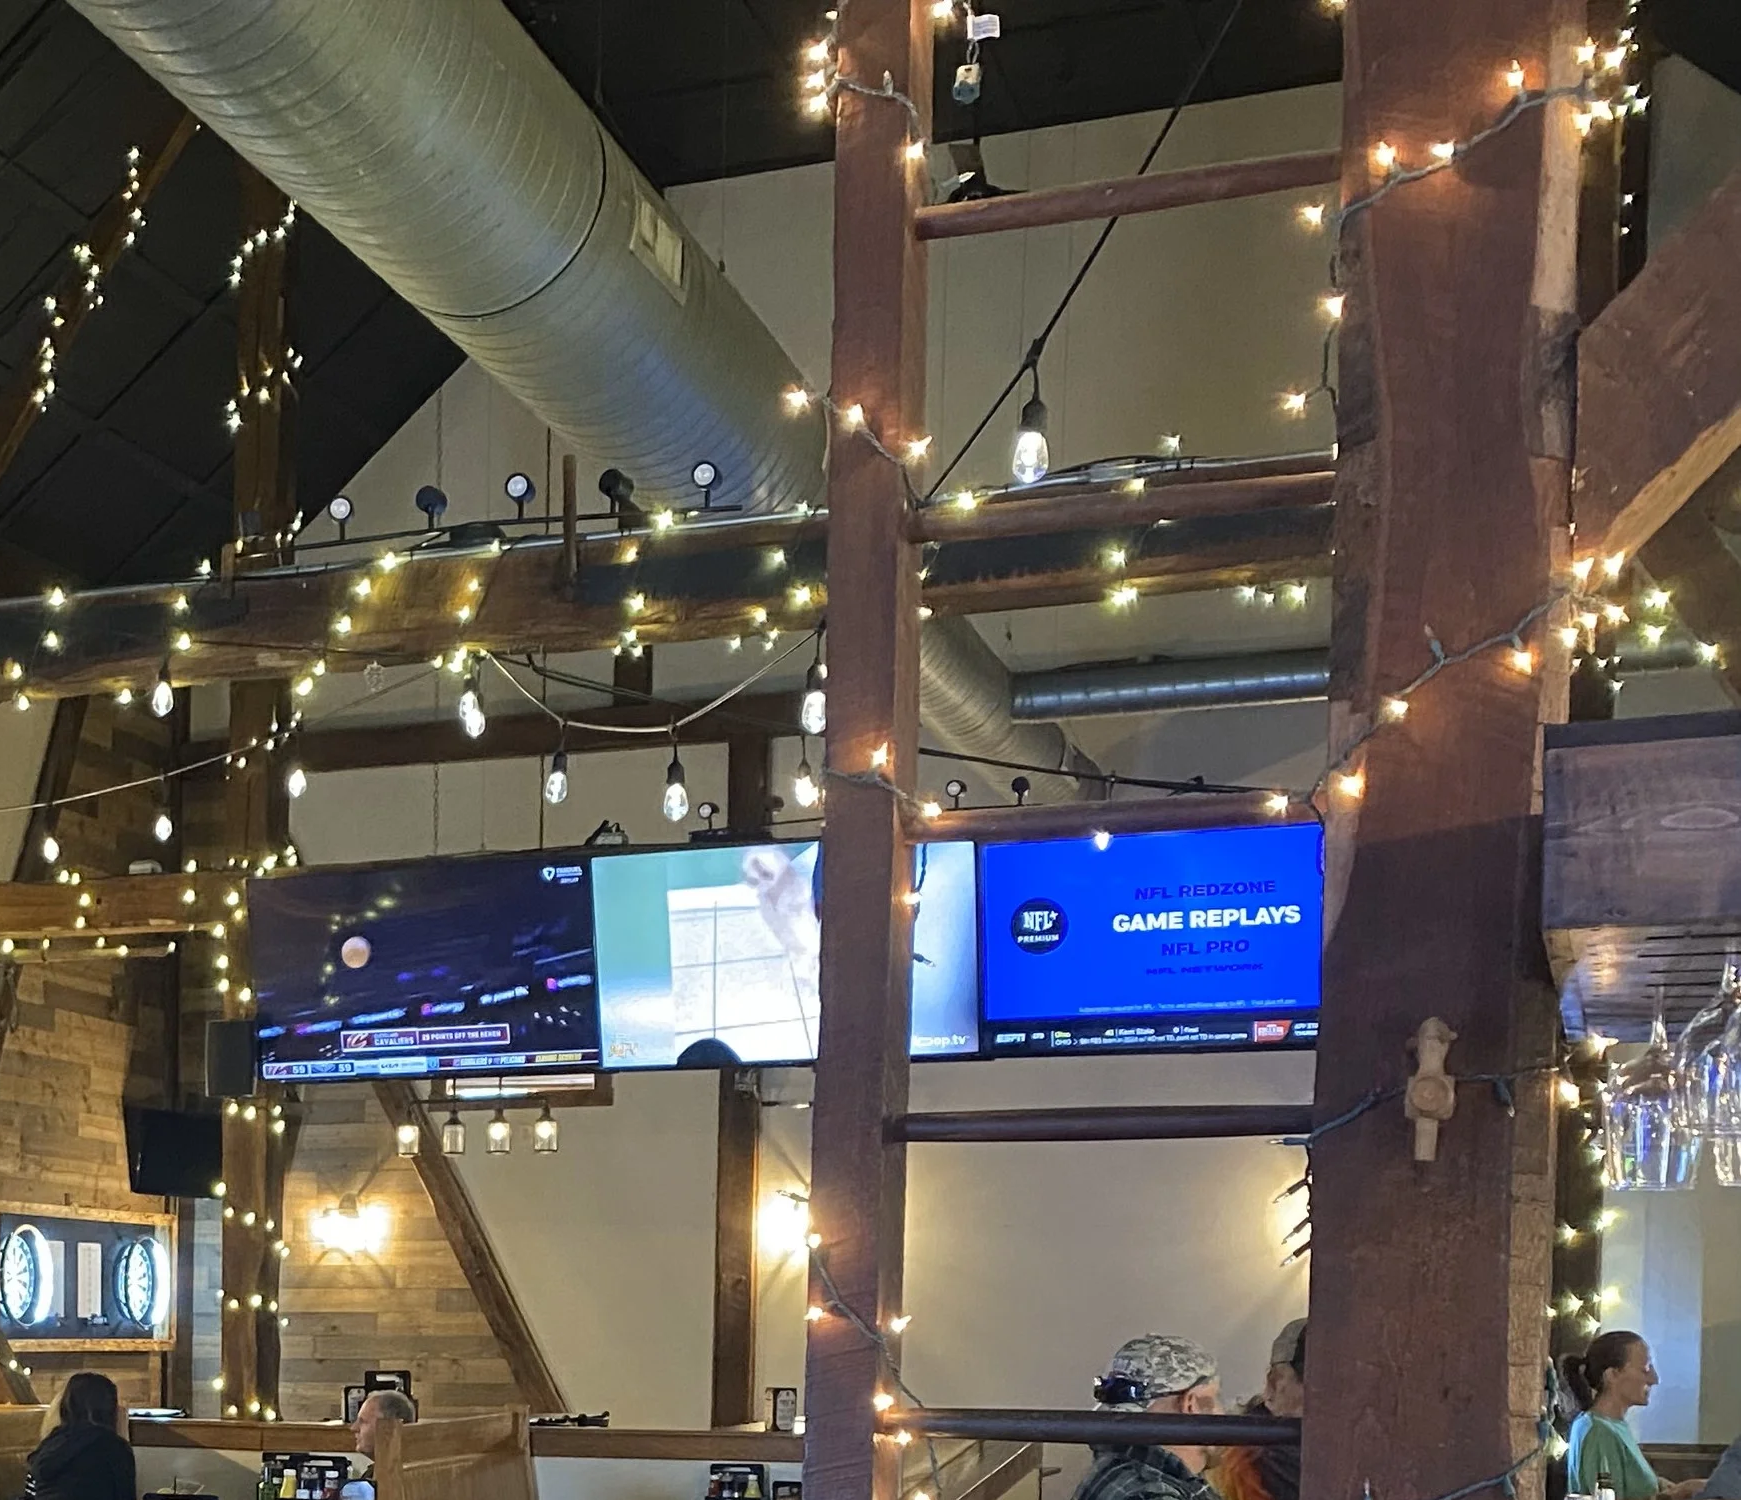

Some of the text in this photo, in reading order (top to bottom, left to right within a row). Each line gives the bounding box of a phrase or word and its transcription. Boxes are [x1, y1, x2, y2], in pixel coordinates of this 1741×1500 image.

[1135, 880, 1277, 901] NFL REDZONE
[1112, 904, 1301, 933] GAME REPLAYS
[1017, 933, 1060, 944] PREMIUM
[1161, 939, 1250, 957] NFL PRO
[374, 1036, 415, 1046] CAVALIERS
[292, 1065, 306, 1075] 59
[338, 1063, 353, 1073] 59
